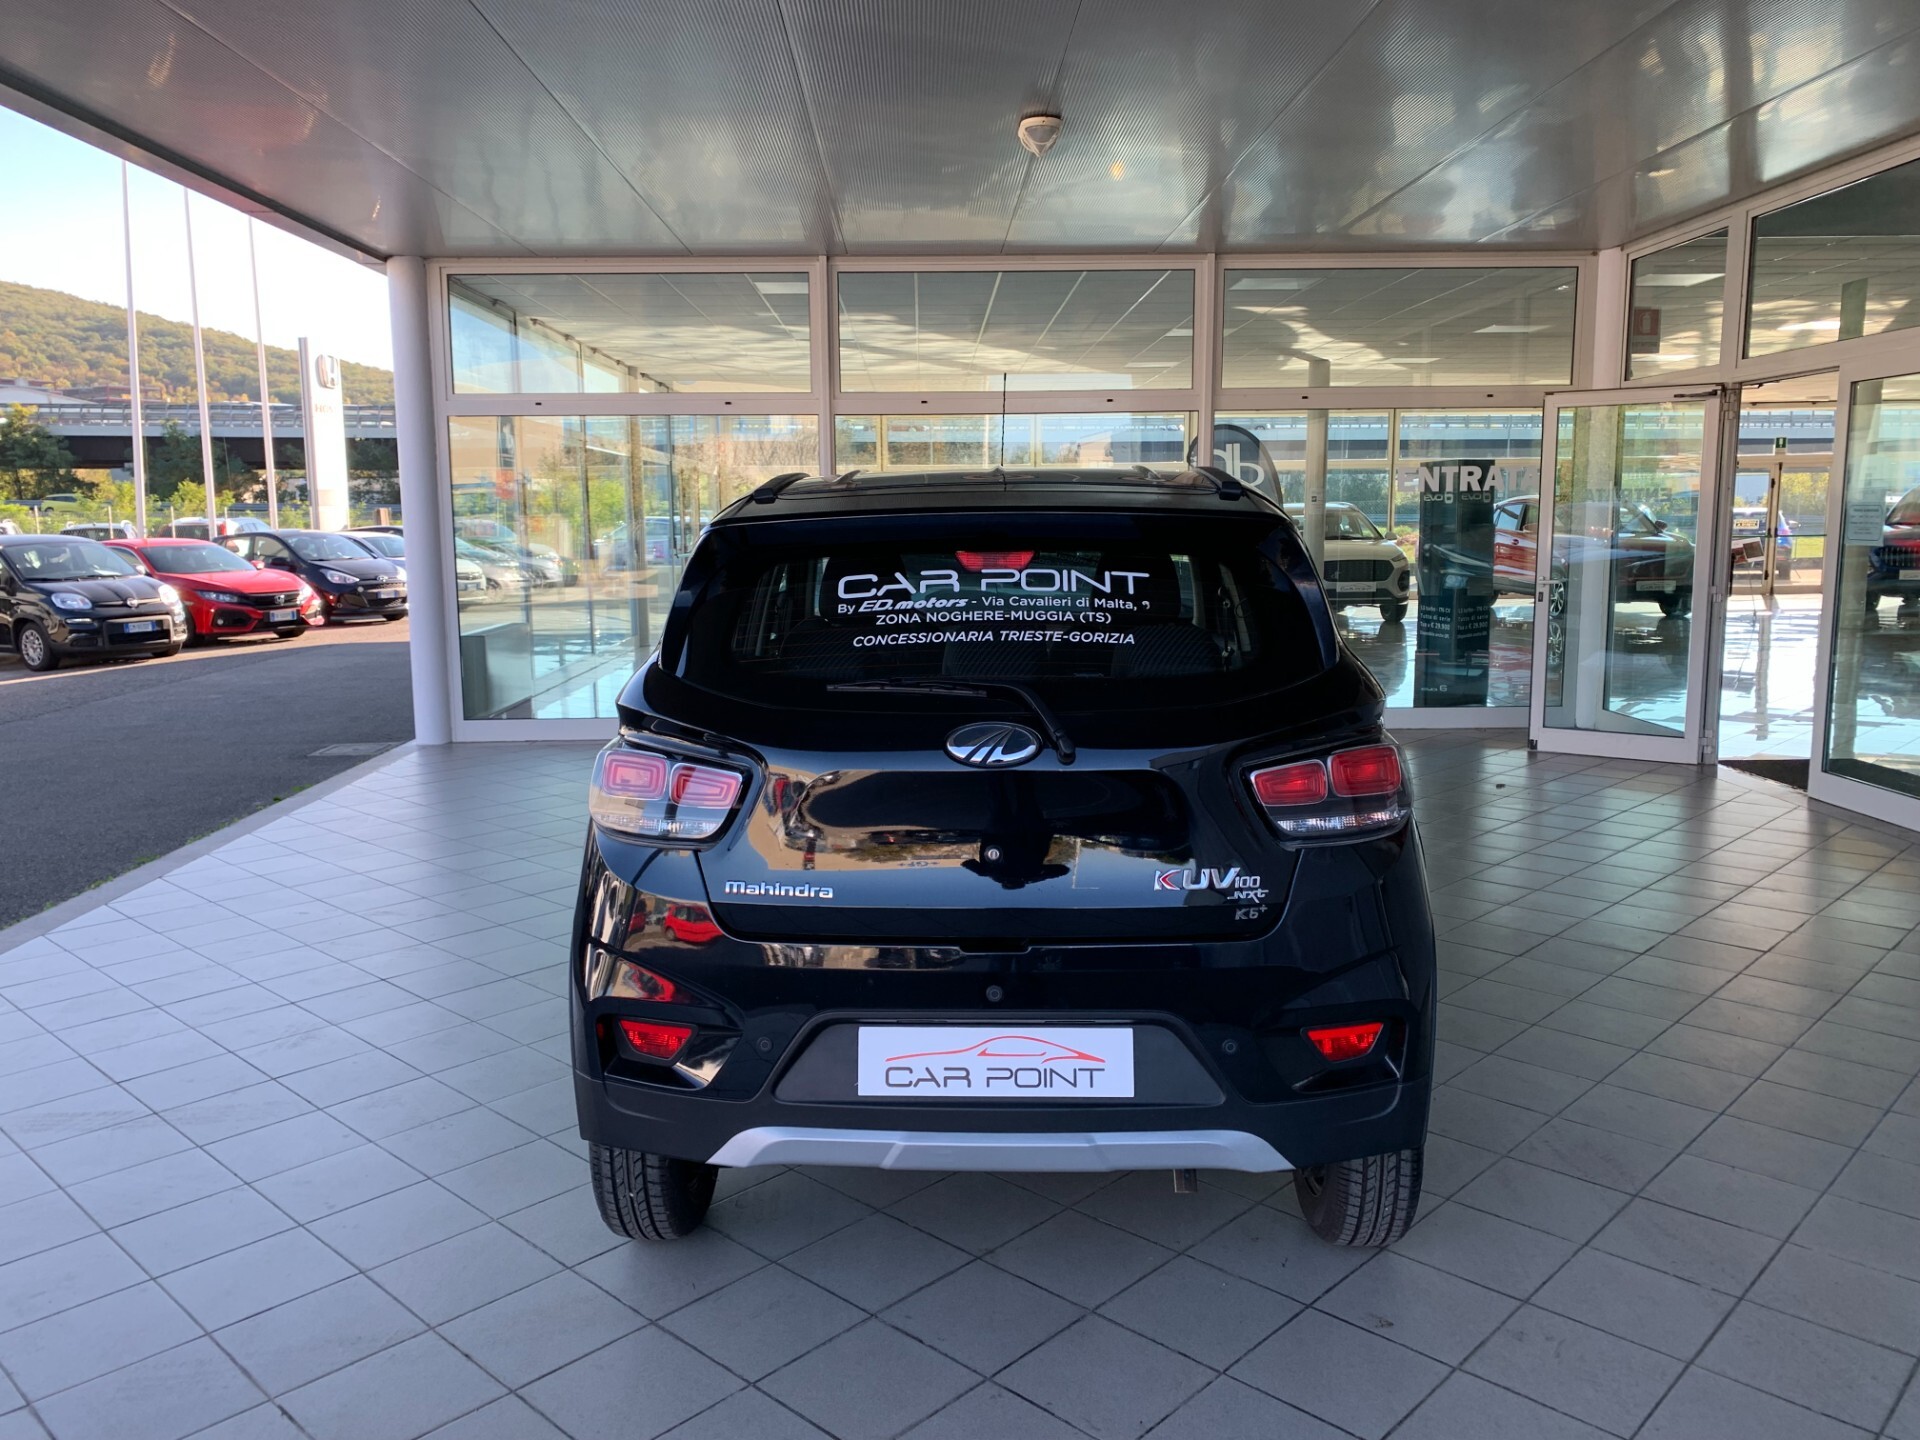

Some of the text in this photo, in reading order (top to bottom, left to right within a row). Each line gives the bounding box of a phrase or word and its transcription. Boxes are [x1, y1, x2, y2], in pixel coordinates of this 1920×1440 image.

[1397, 464, 1541, 492] ENTRATA
[838, 568, 1150, 599] CAR POINT
[837, 604, 856, 615] By
[858, 597, 969, 612] ED.motors
[981, 596, 1004, 606] Via
[1009, 596, 1072, 607] Cavalieri
[1076, 597, 1089, 608] di
[1094, 598, 1137, 611] Malta,
[875, 610, 1112, 626] ZONA NOGHERE-MUGGIA (TS)
[852, 630, 1135, 647] CONCESSIONARIA TRIESTE-GORIZIA
[725, 881, 833, 898] Mahindra
[885, 1066, 1105, 1089] CAR POINT
